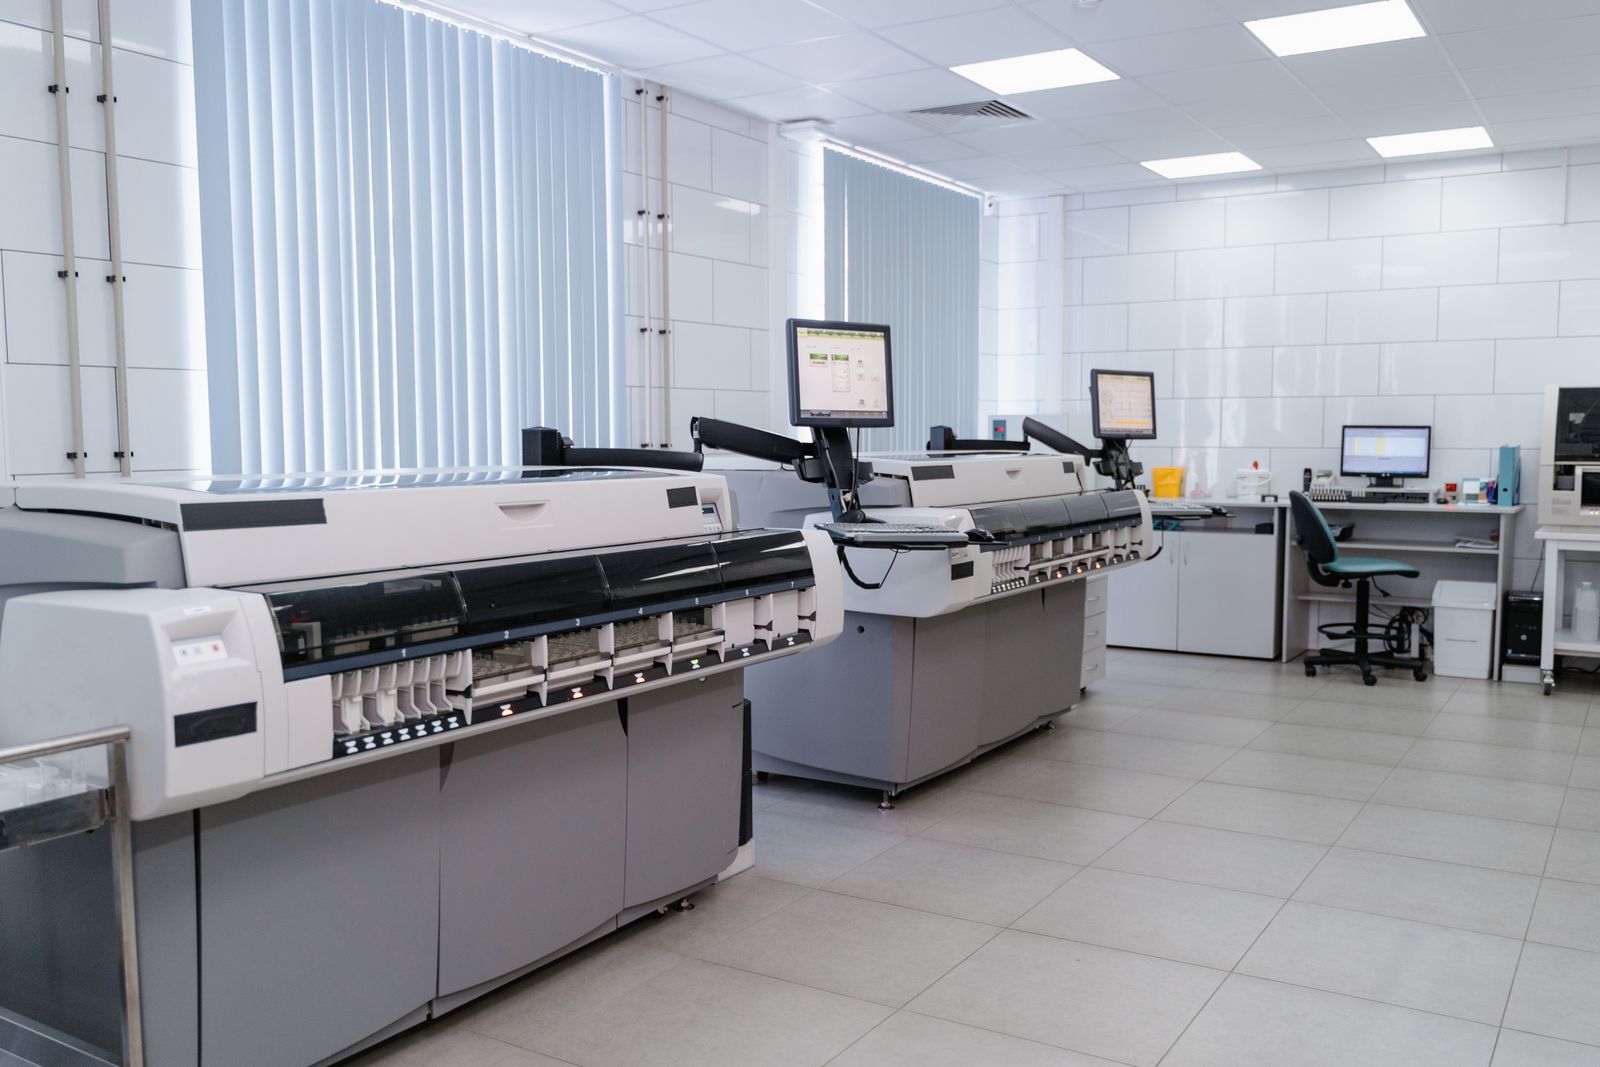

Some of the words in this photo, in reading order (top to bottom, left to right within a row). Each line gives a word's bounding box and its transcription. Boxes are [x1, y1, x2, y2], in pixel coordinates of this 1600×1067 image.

[638, 607, 643, 615] 4
[575, 618, 580, 626] 3
[504, 630, 509, 639] 2
[401, 648, 406, 657] 1
